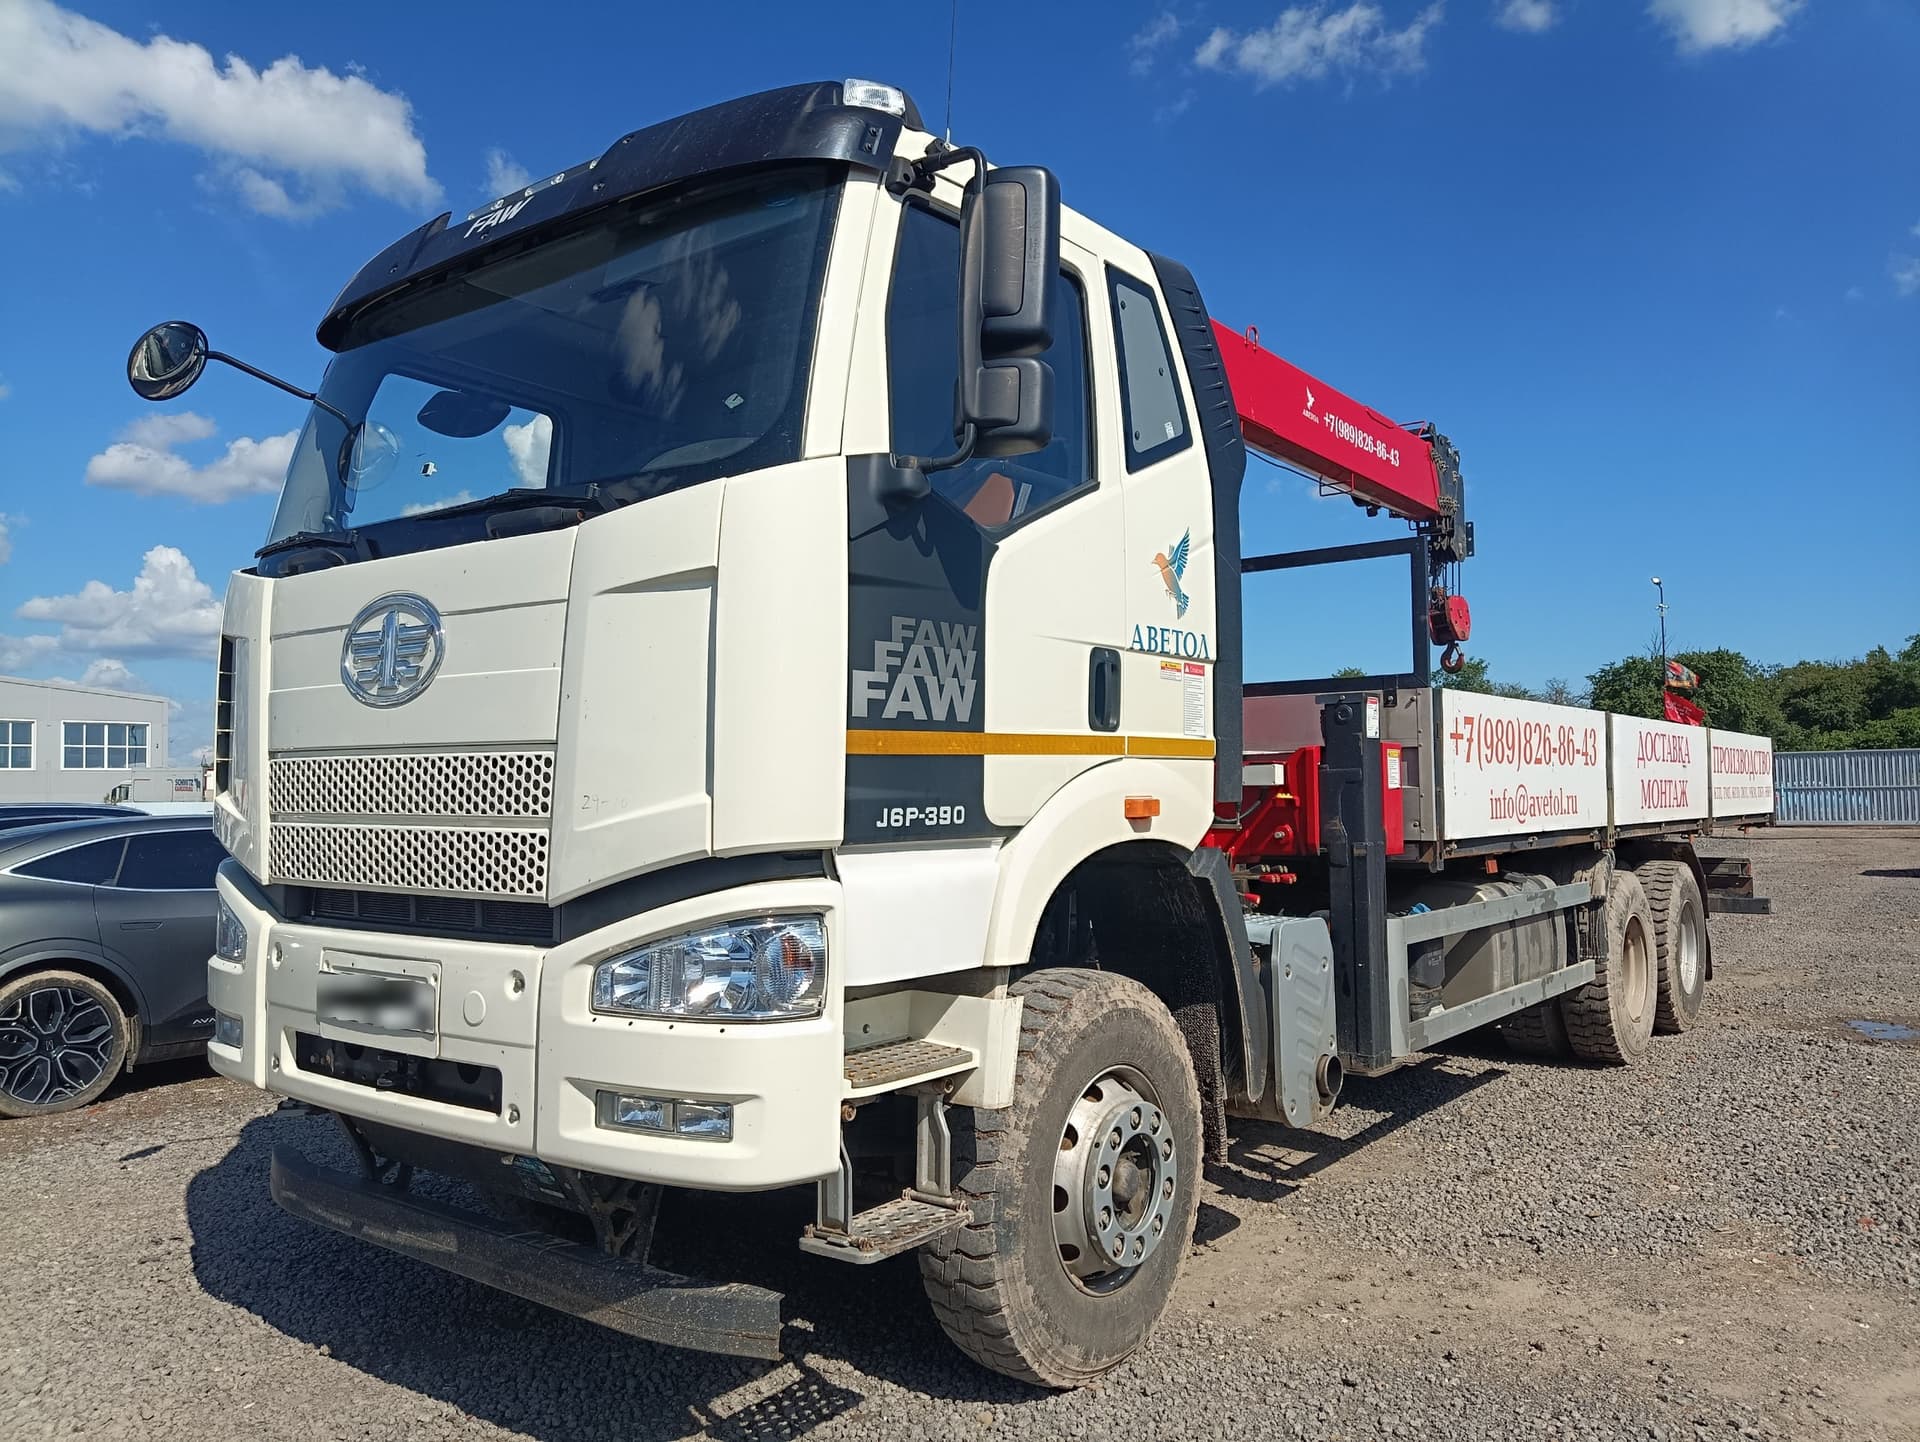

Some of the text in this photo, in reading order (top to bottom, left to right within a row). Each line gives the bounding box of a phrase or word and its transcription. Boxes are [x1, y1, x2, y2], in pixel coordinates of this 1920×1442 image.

[464, 195, 535, 239] FAW
[1323, 411, 1400, 468] +7(989)826-86-43
[892, 615, 977, 657] FAW
[1126, 623, 1210, 660] АВЕТОЛ
[875, 639, 977, 686] FAW
[852, 669, 977, 723] FAW
[1450, 713, 1597, 772] +7(989)826-86-43
[1637, 730, 1691, 769] ДОСТАВКА
[1713, 746, 1771, 782] ПРОИЗВОДСТВО
[1490, 784, 1579, 824] info@avetol.ru
[1640, 779, 1689, 809] МОНТАЖ
[876, 805, 965, 828] J6P-390
